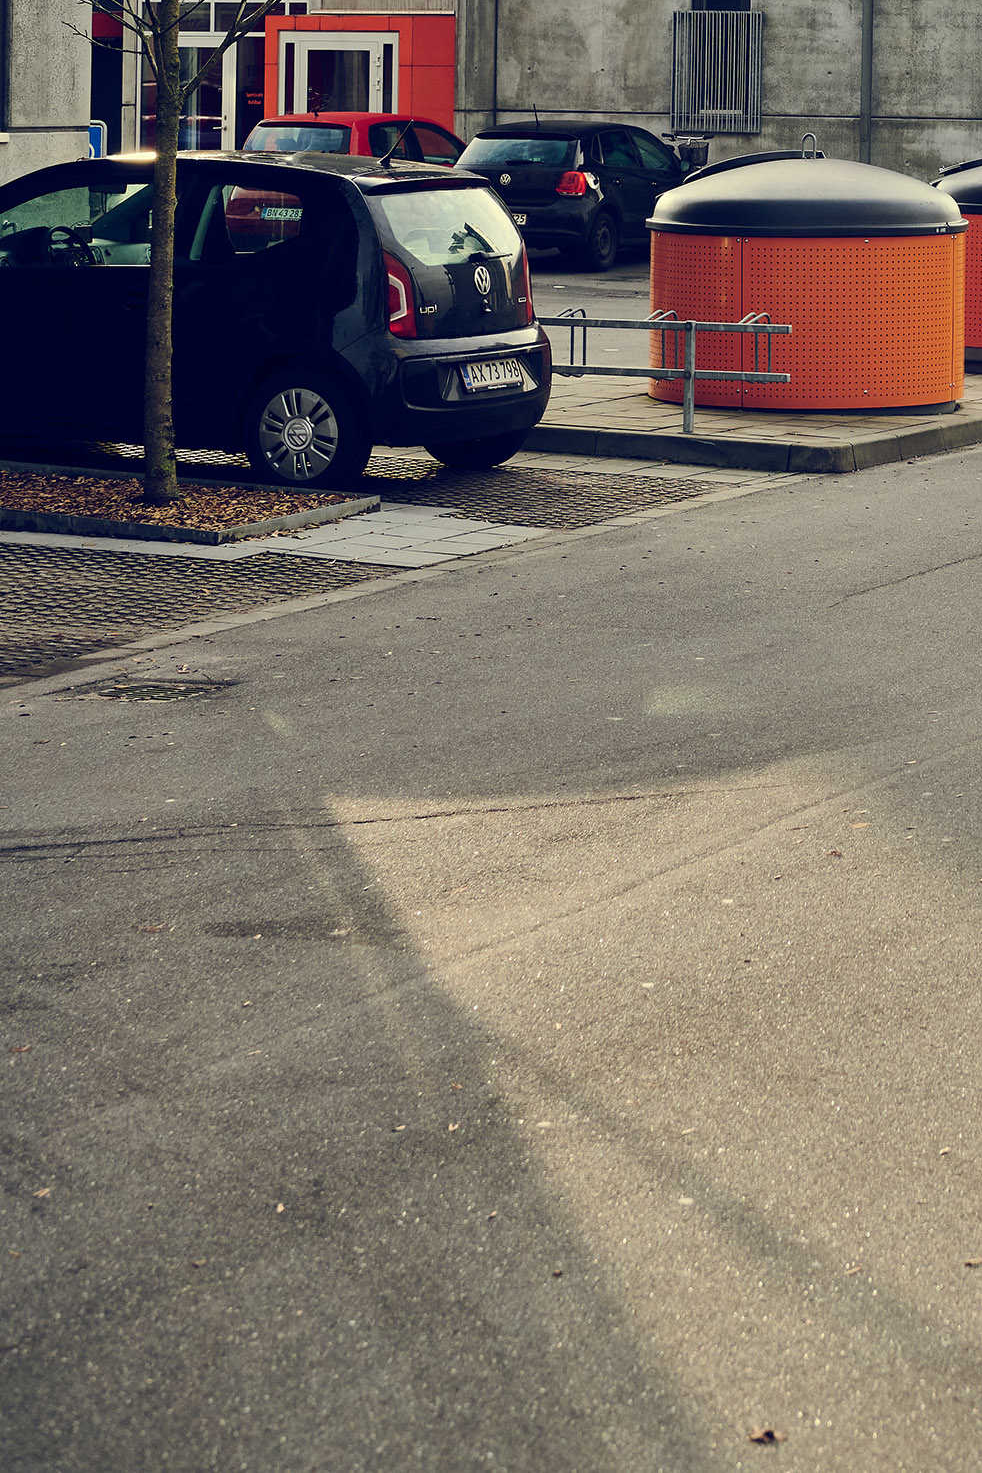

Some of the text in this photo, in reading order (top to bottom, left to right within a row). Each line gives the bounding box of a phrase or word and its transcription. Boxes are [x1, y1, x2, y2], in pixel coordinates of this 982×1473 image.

[470, 360, 520, 383] AX 73 798
